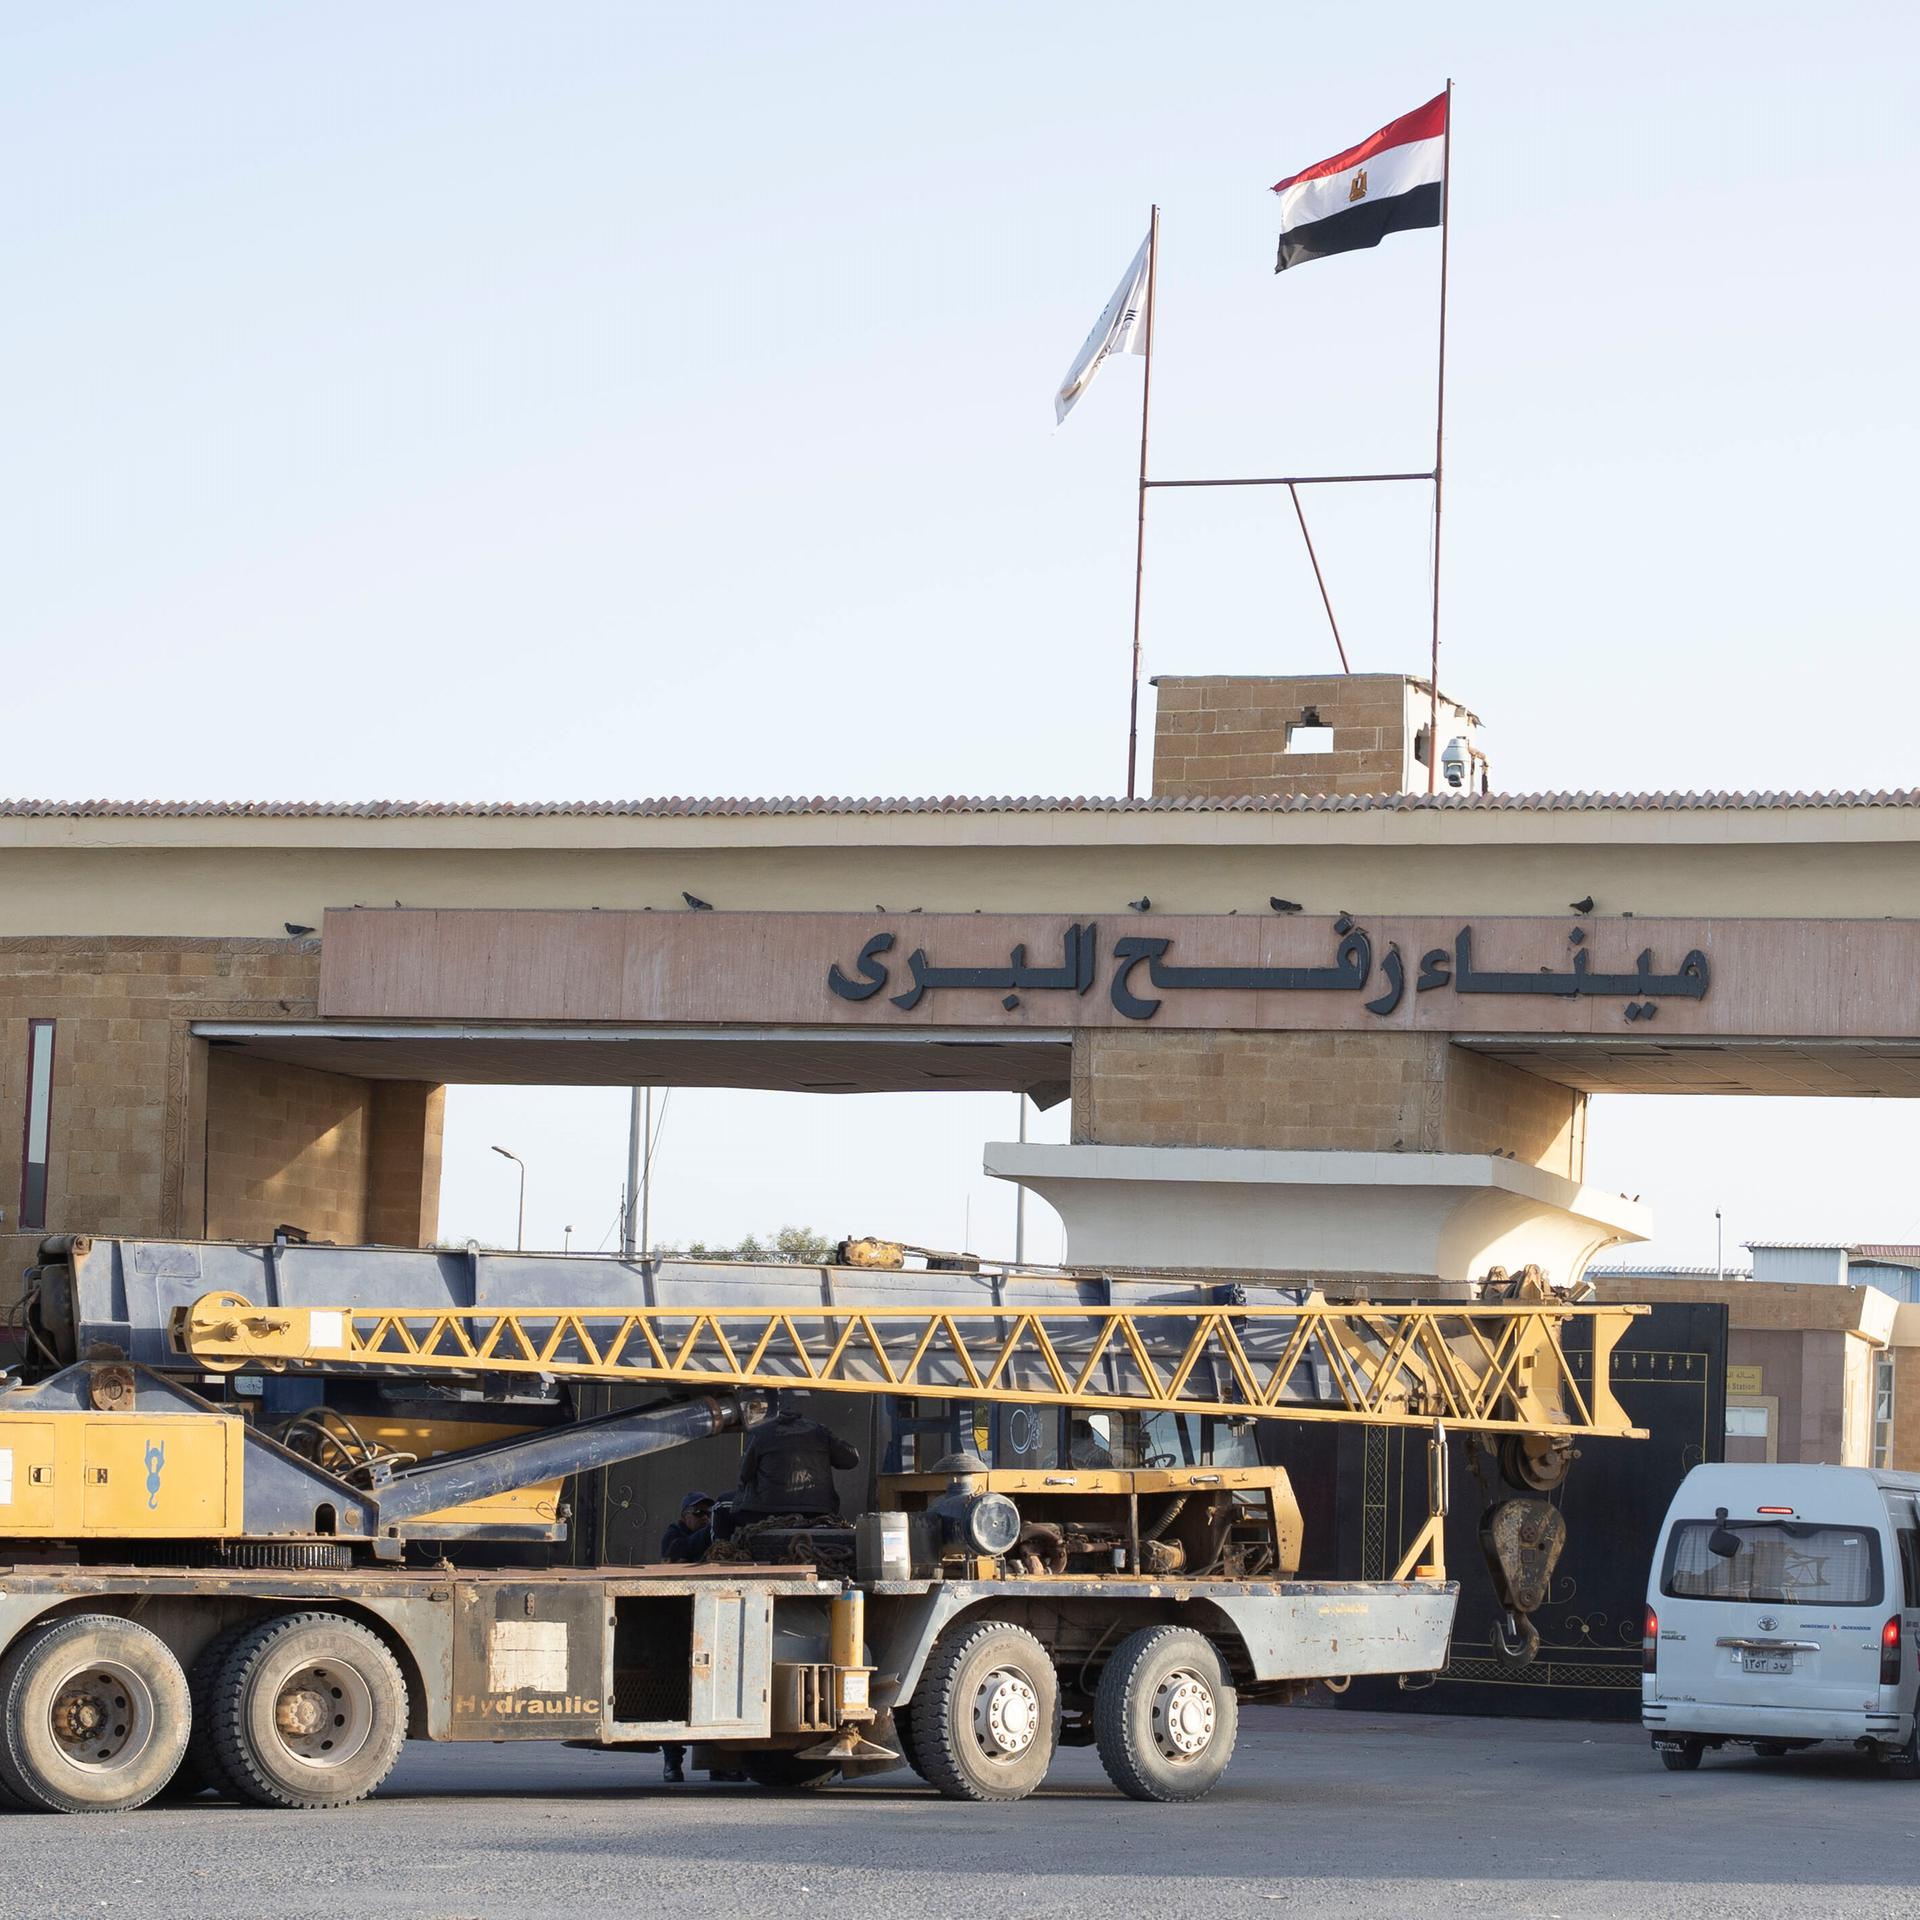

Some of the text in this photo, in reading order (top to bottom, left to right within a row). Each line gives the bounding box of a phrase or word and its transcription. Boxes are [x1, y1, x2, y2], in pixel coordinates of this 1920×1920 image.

[828, 914, 1711, 1021] ميناء رفح البرى
[456, 1695, 600, 1717] Hydraulic
